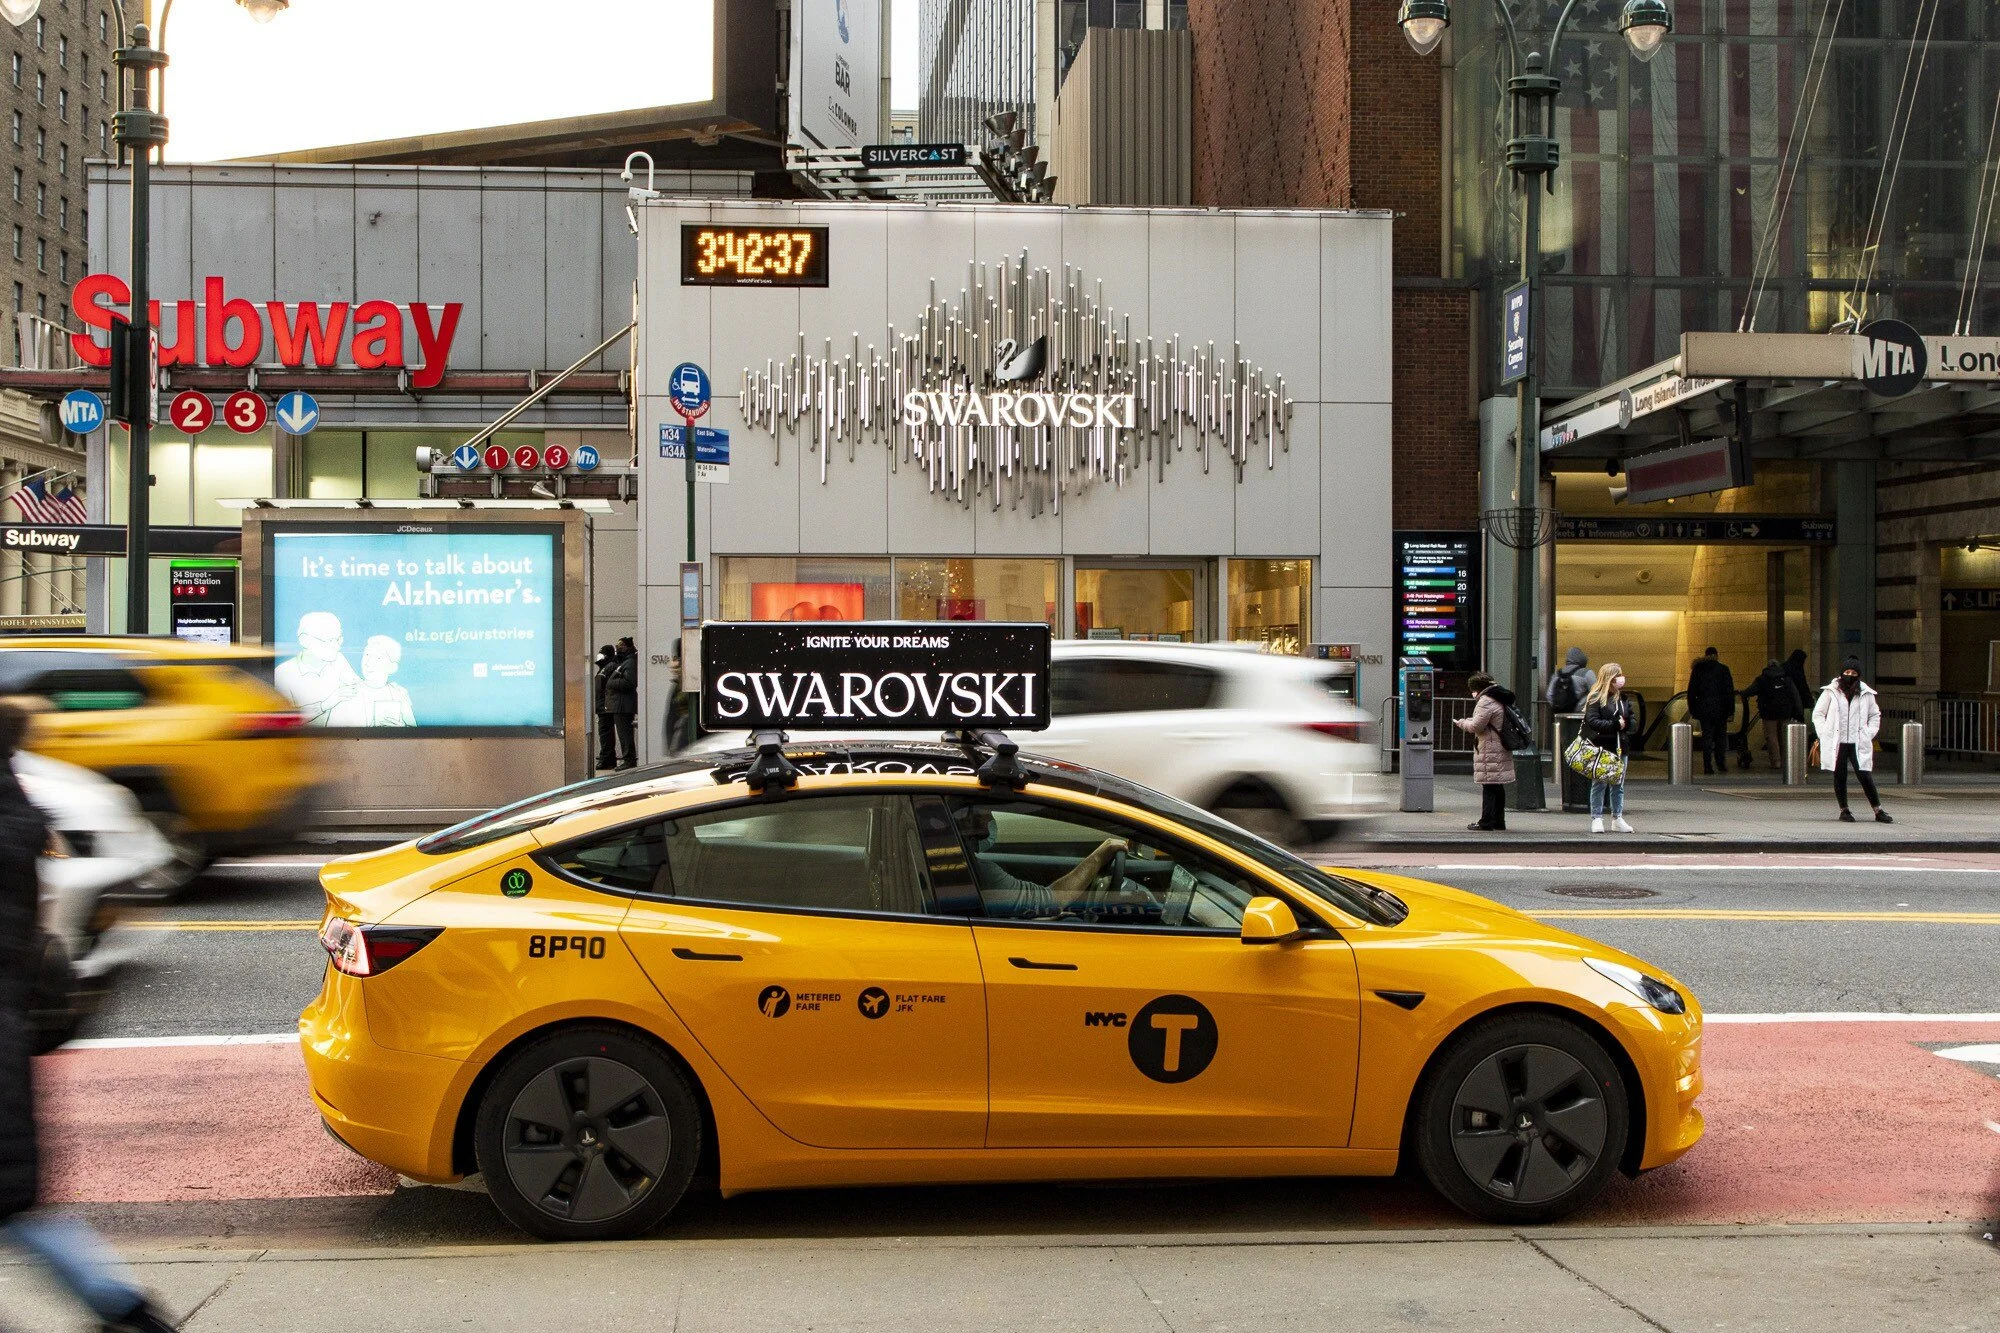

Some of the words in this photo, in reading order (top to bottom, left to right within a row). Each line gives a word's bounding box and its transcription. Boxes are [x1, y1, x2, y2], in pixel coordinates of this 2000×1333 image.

[836, 61, 850, 97] BAR
[869, 149, 958, 162] SILVERCAST
[698, 232, 811, 274] 3:42:37
[1511, 294, 1523, 310] NYPD
[72, 274, 464, 388] Subway
[1855, 336, 1915, 380] MTA
[1941, 345, 2000, 372] Lon
[673, 398, 682, 410] NO
[682, 402, 708, 416] STANDING
[1635, 395, 1652, 412] Long
[1654, 382, 1676, 404] Island
[60, 400, 98, 425] MTA
[182, 398, 204, 426] 2
[234, 398, 256, 426] 3
[903, 391, 1135, 428] SWAROVSKI
[662, 428, 680, 440] M34
[491, 450, 499, 466] 1
[521, 450, 532, 466] 2
[550, 449, 561, 465] 3
[575, 450, 596, 464] MTA
[662, 446, 686, 458] M34A
[1801, 521, 1834, 530] Subway
[6, 529, 80, 549] Subway
[302, 556, 334, 578] It’s
[340, 556, 390, 577] time
[396, 558, 420, 576] to
[425, 554, 466, 575] talk
[472, 554, 533, 574] about
[405, 627, 534, 644] alz.org/ourstories
[806, 636, 851, 648] IGNITE
[854, 636, 890, 648] YOUR
[894, 636, 949, 648] DREAMS
[716, 672, 1037, 718] SWAROVSKI
[528, 935, 606, 959] 8P90
[796, 994, 841, 1002] METERED
[896, 995, 917, 1003] FLAT
[1085, 1012, 1127, 1027] NYC
[1150, 1013, 1198, 1072] T
